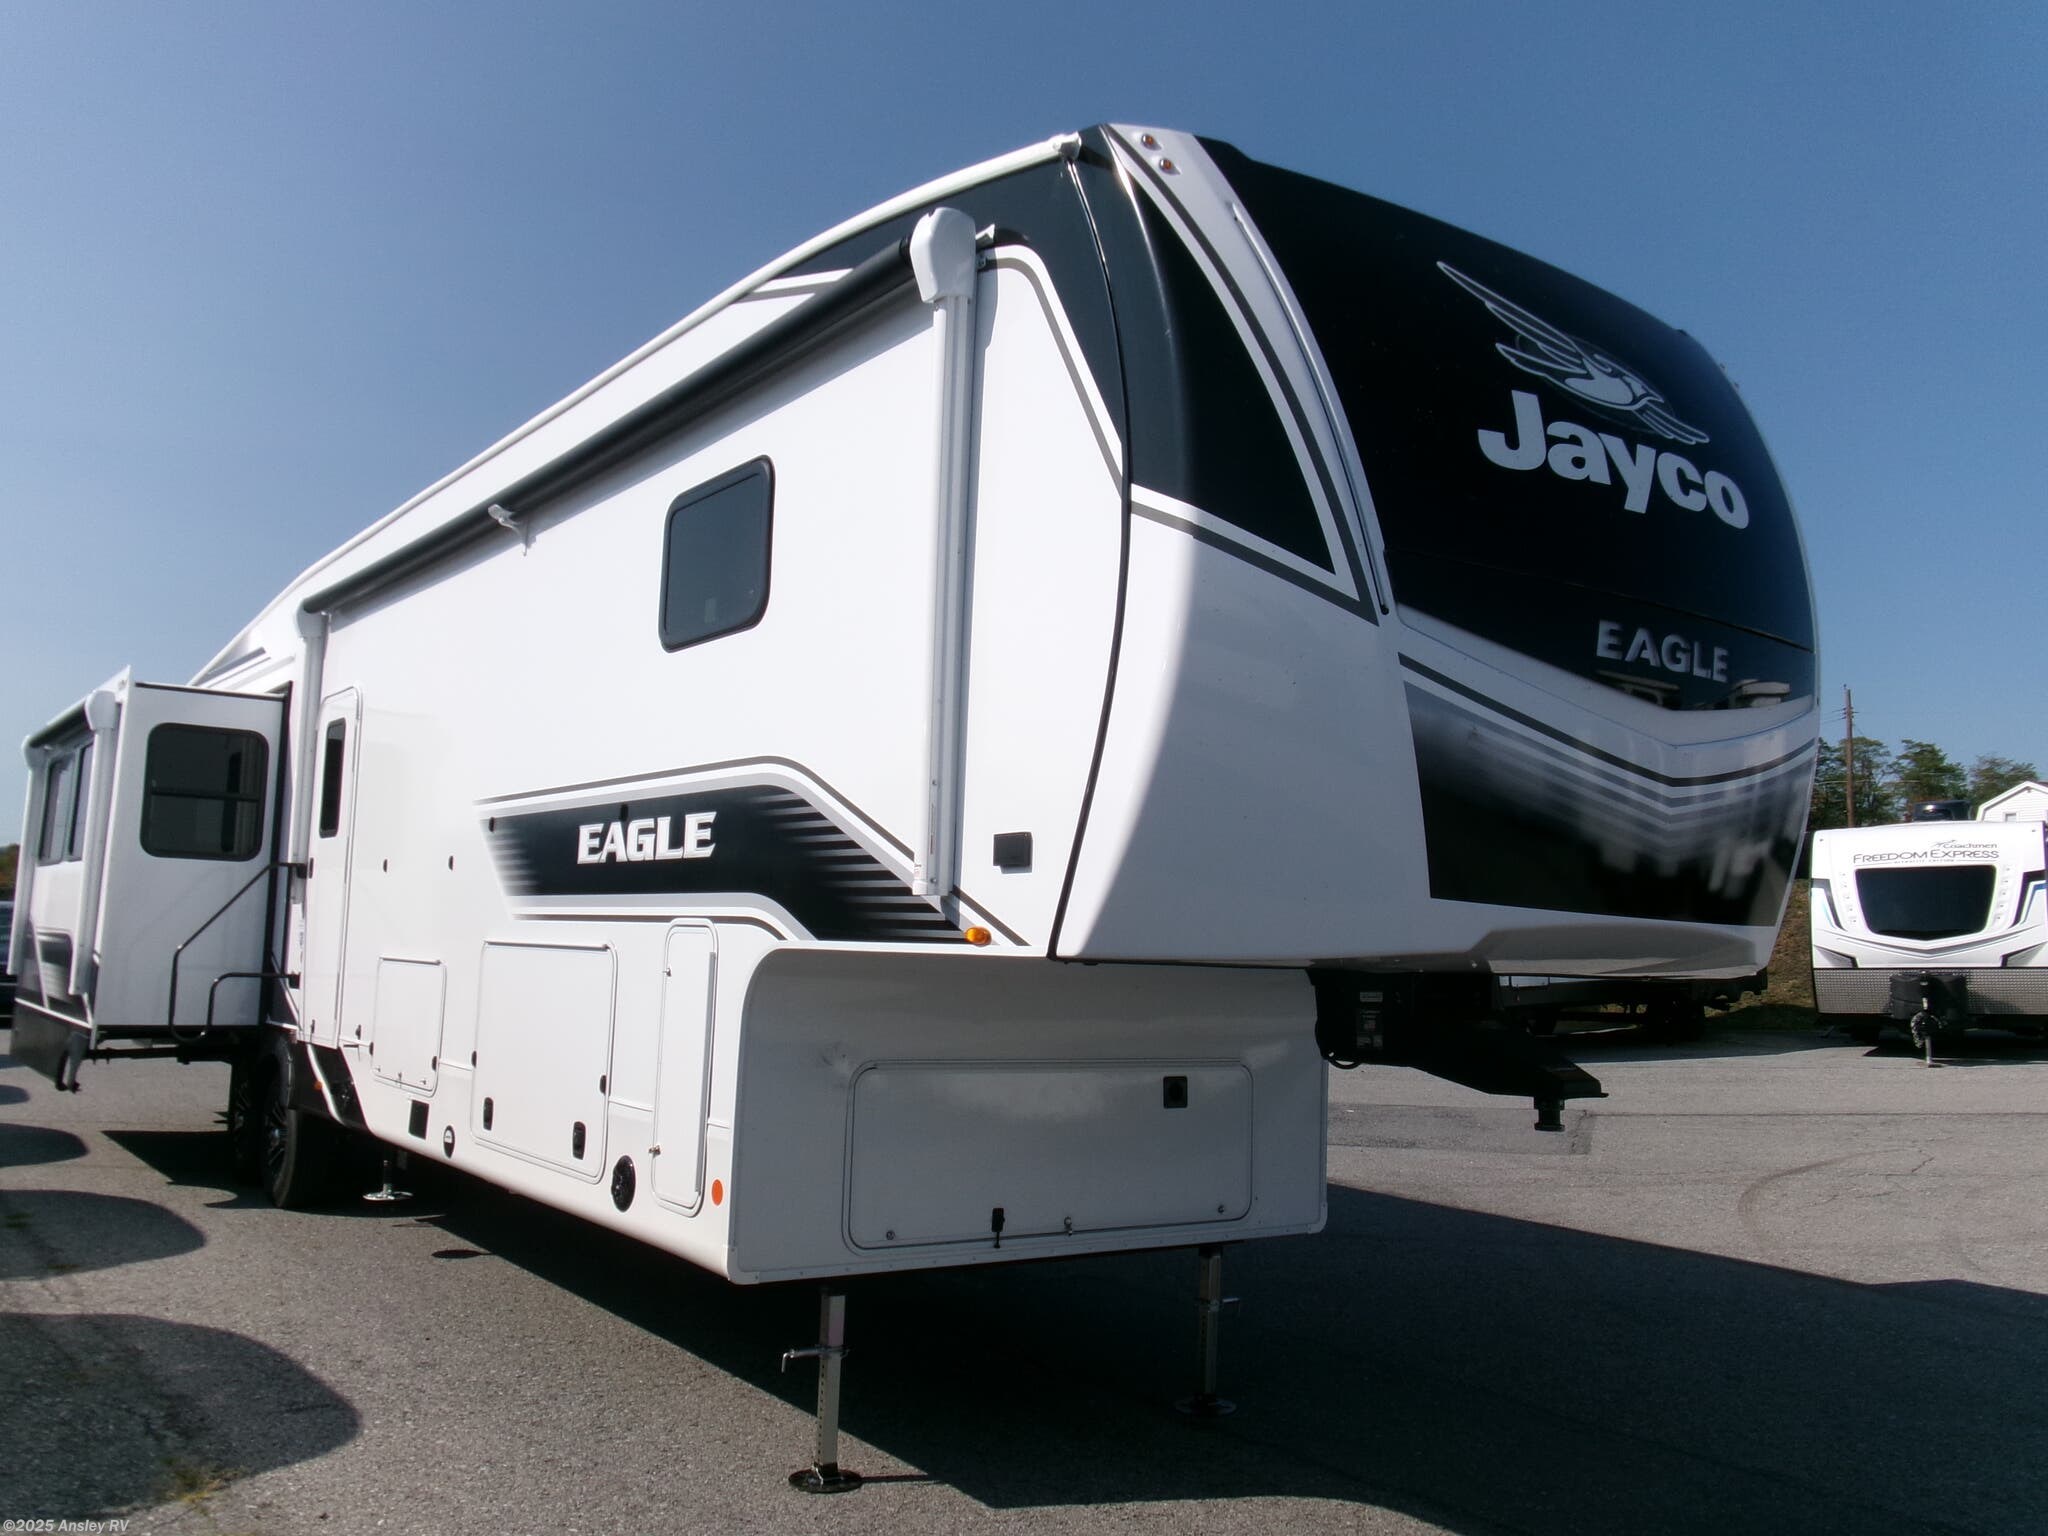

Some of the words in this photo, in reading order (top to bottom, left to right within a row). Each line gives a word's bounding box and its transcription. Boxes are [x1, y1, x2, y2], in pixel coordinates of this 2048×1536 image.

[1478, 390, 1749, 529] Jayco
[1597, 620, 1730, 682] EAGLE
[577, 811, 717, 864] EAGLE
[1853, 850, 1928, 864] FREEDOM
[1930, 848, 2000, 859] EXPRESS
